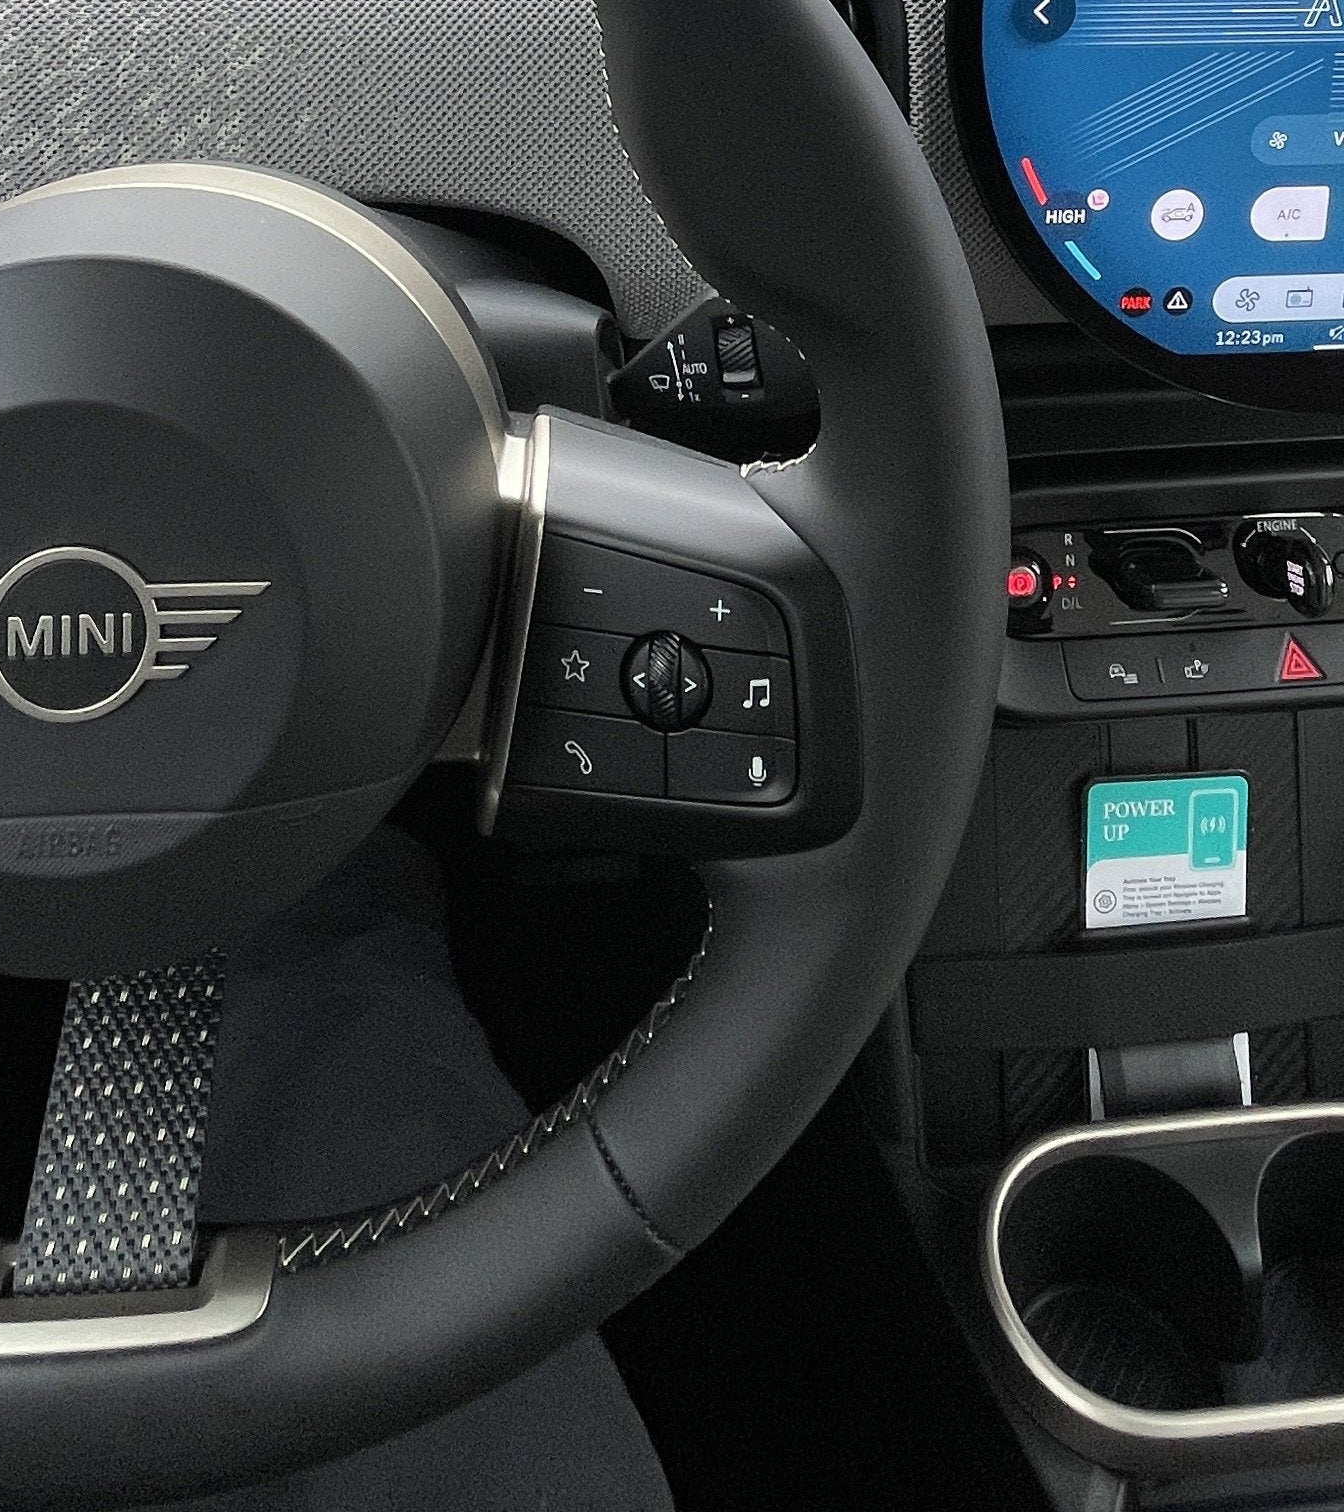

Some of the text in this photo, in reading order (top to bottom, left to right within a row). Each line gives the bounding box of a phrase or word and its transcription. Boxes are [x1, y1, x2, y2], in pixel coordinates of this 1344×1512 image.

[1044, 208, 1086, 224] HIGH
[1276, 208, 1302, 221] A/C
[1120, 296, 1152, 310] PARK
[682, 362, 708, 375] AUTO
[1256, 519, 1299, 533] ENGINE
[1064, 533, 1074, 546] R
[1065, 554, 1075, 567] N
[1052, 574, 1063, 591] P
[1061, 596, 1084, 610] D/L
[7, 611, 133, 659] MINI
[1103, 798, 1176, 820] POWER
[1104, 823, 1130, 842] UP
